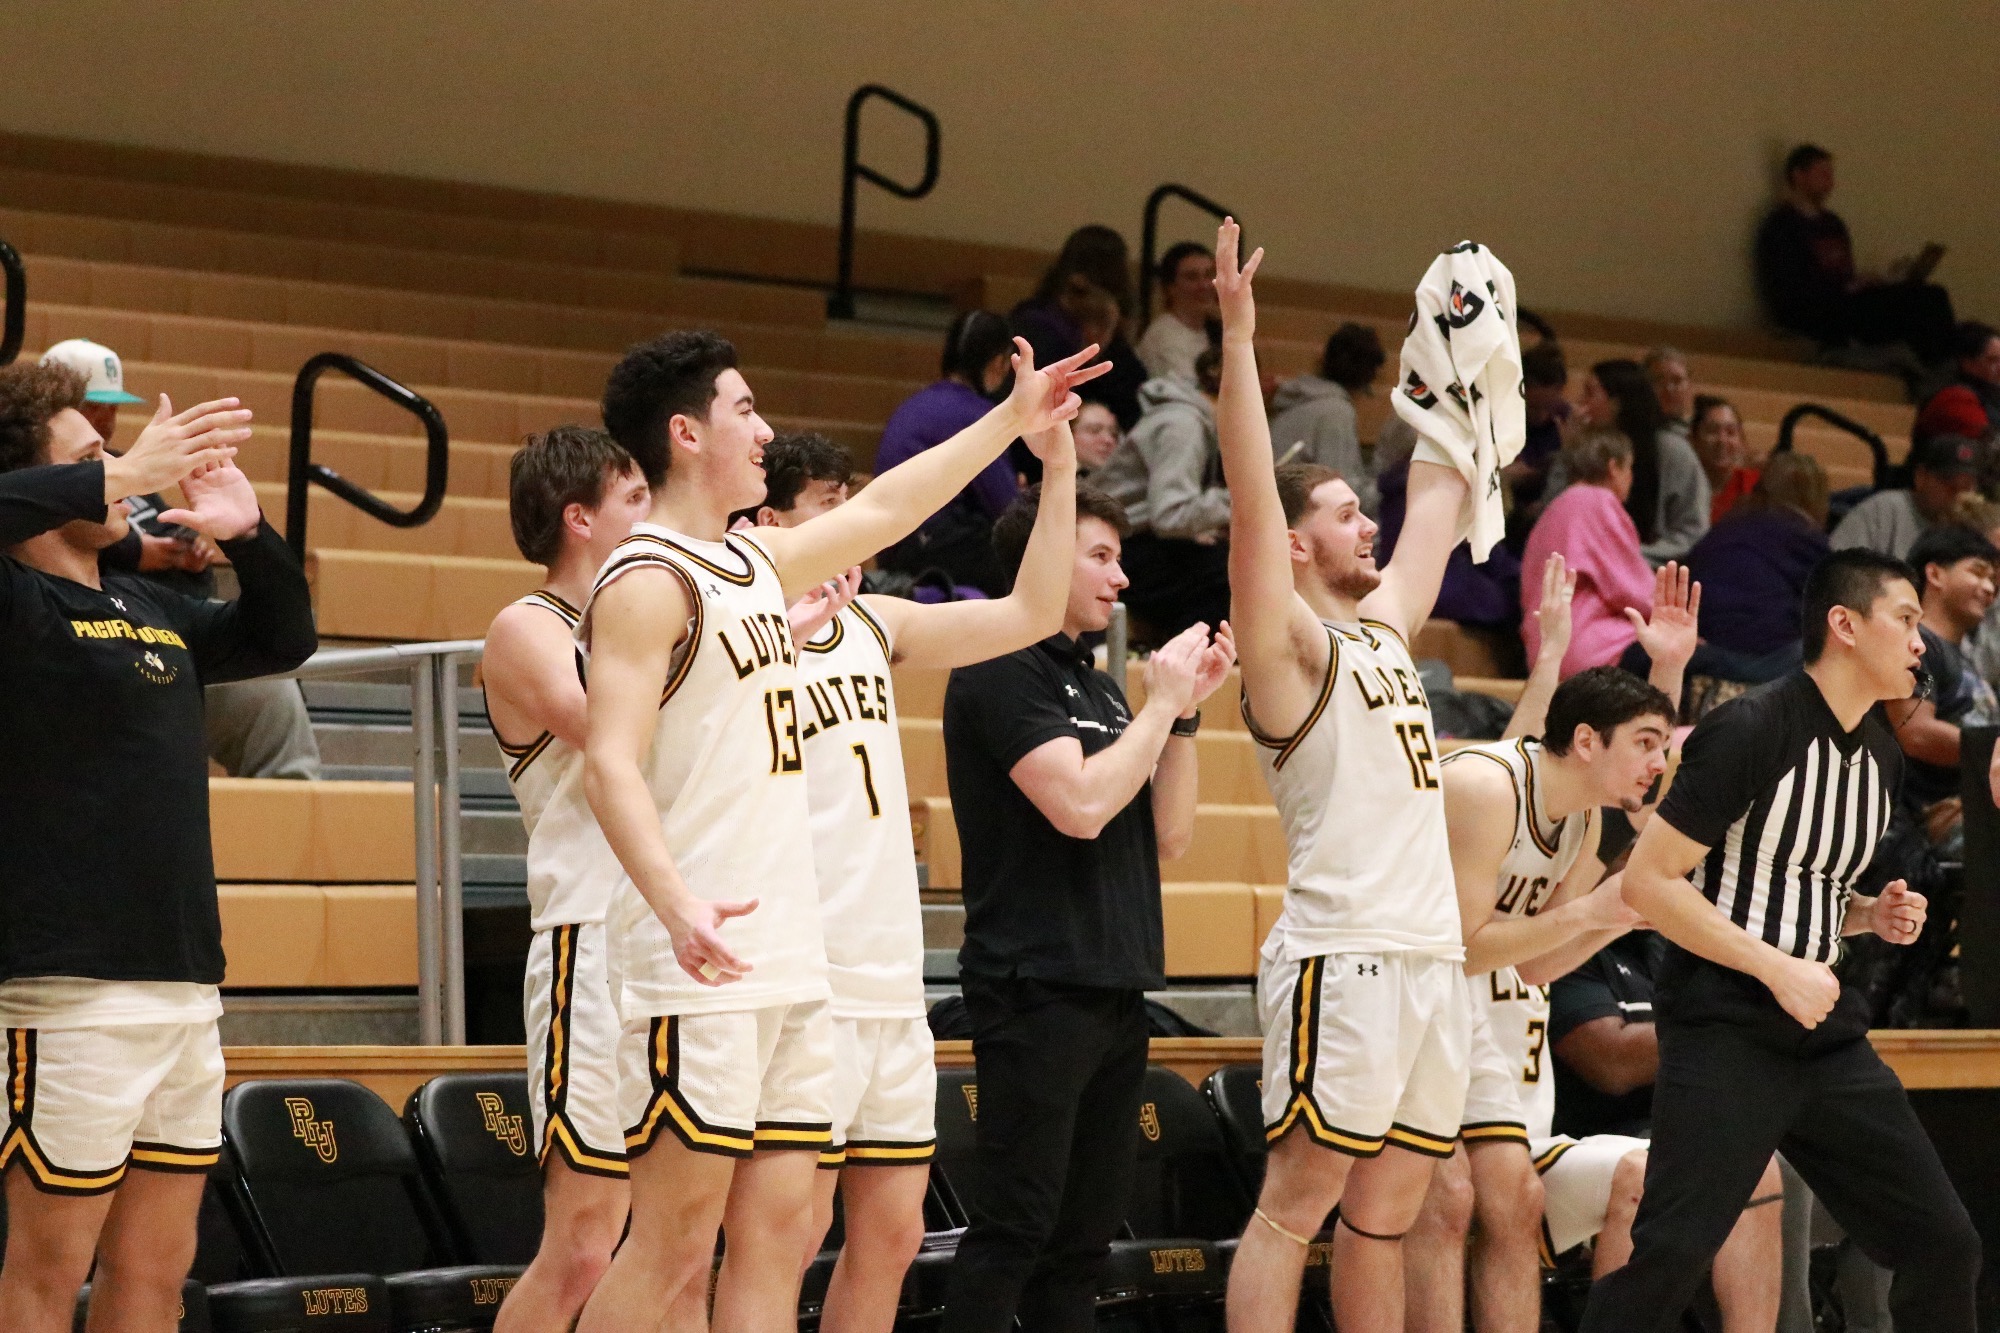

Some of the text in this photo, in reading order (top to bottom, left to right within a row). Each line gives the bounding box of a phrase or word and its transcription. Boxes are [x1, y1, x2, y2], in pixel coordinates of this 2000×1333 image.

[764, 687, 803, 776] 13
[1393, 720, 1440, 791] 12
[849, 741, 882, 820] 1
[1521, 1017, 1546, 1086] 3
[284, 1096, 339, 1165] PLU
[476, 1091, 528, 1158] PLU
[470, 1278, 520, 1304] LUT
[1149, 1247, 1206, 1274] LUTES
[302, 1286, 369, 1316] LUTES
